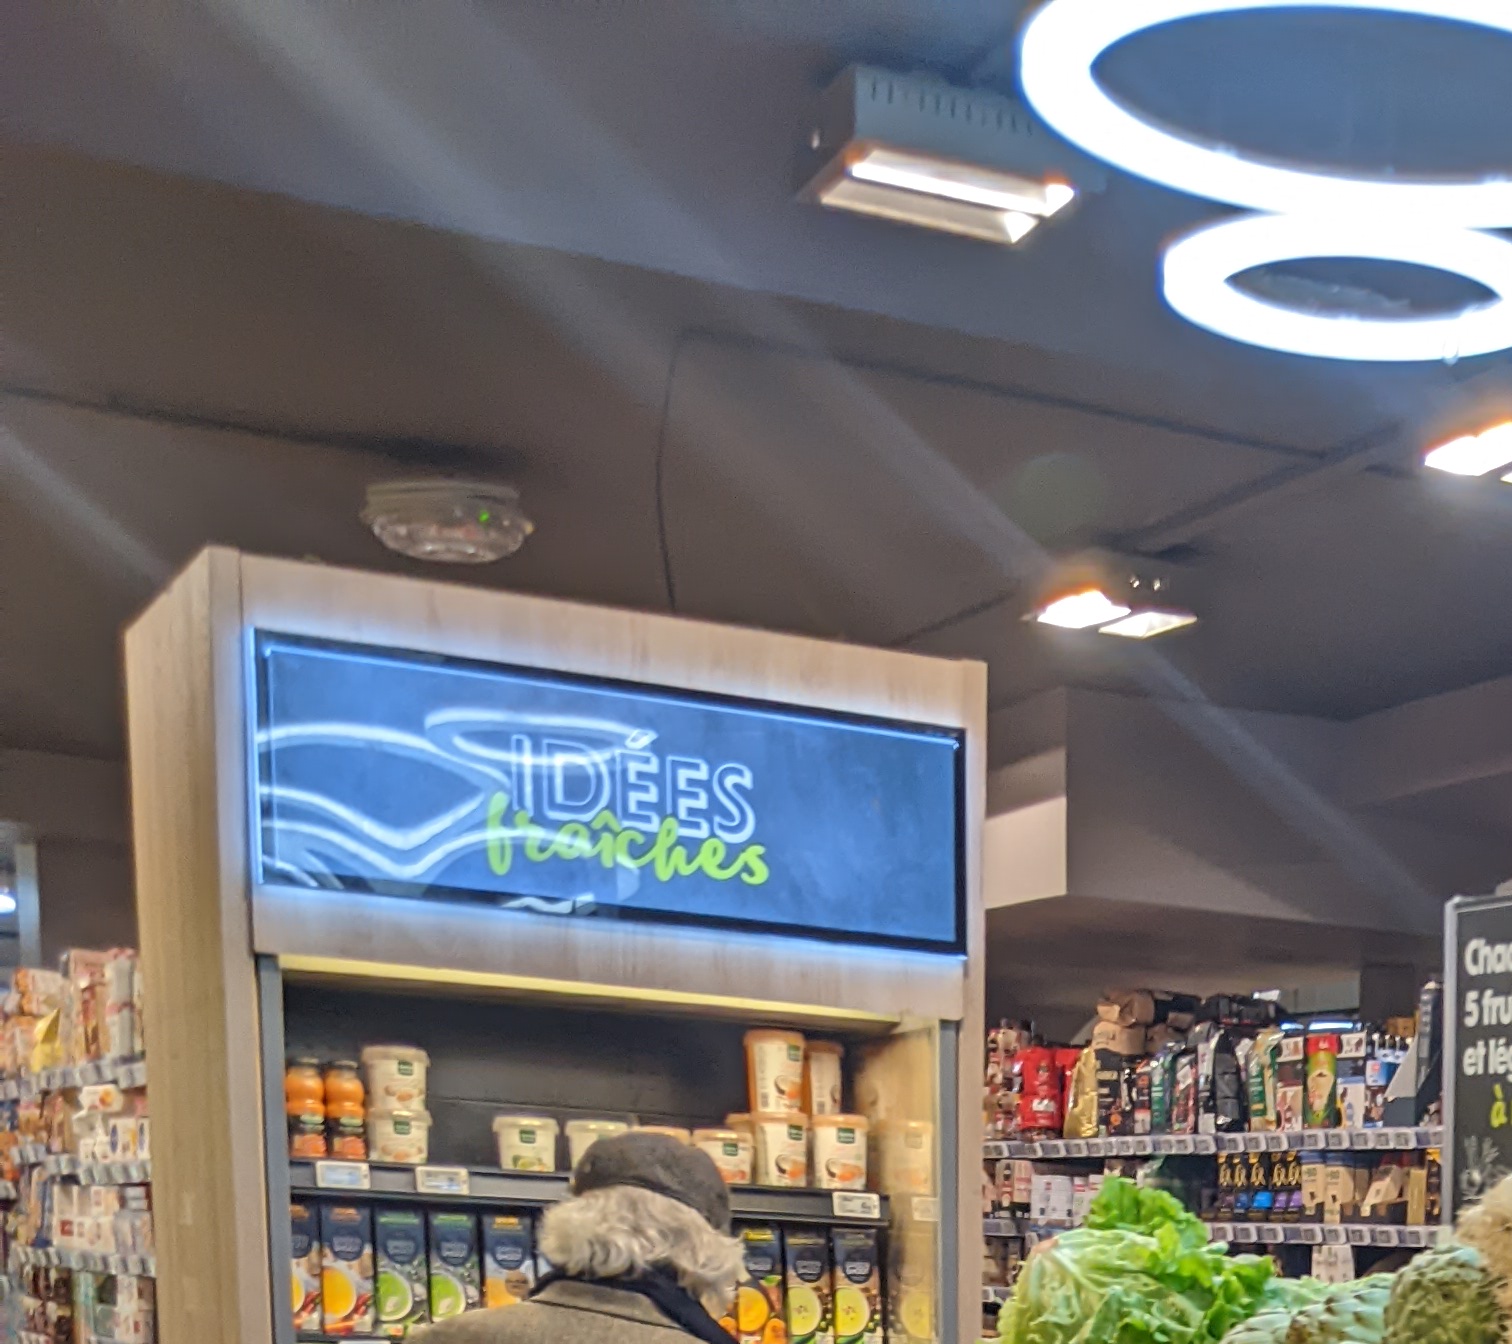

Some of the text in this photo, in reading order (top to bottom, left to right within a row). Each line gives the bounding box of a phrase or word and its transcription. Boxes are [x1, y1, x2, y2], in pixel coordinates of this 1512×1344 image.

[510, 729, 756, 844] IDÉES
[486, 791, 770, 886] fraîches
[1464, 991, 1479, 1027] 5
[1463, 1039, 1485, 1076] et
[1490, 1083, 1507, 1128] à
